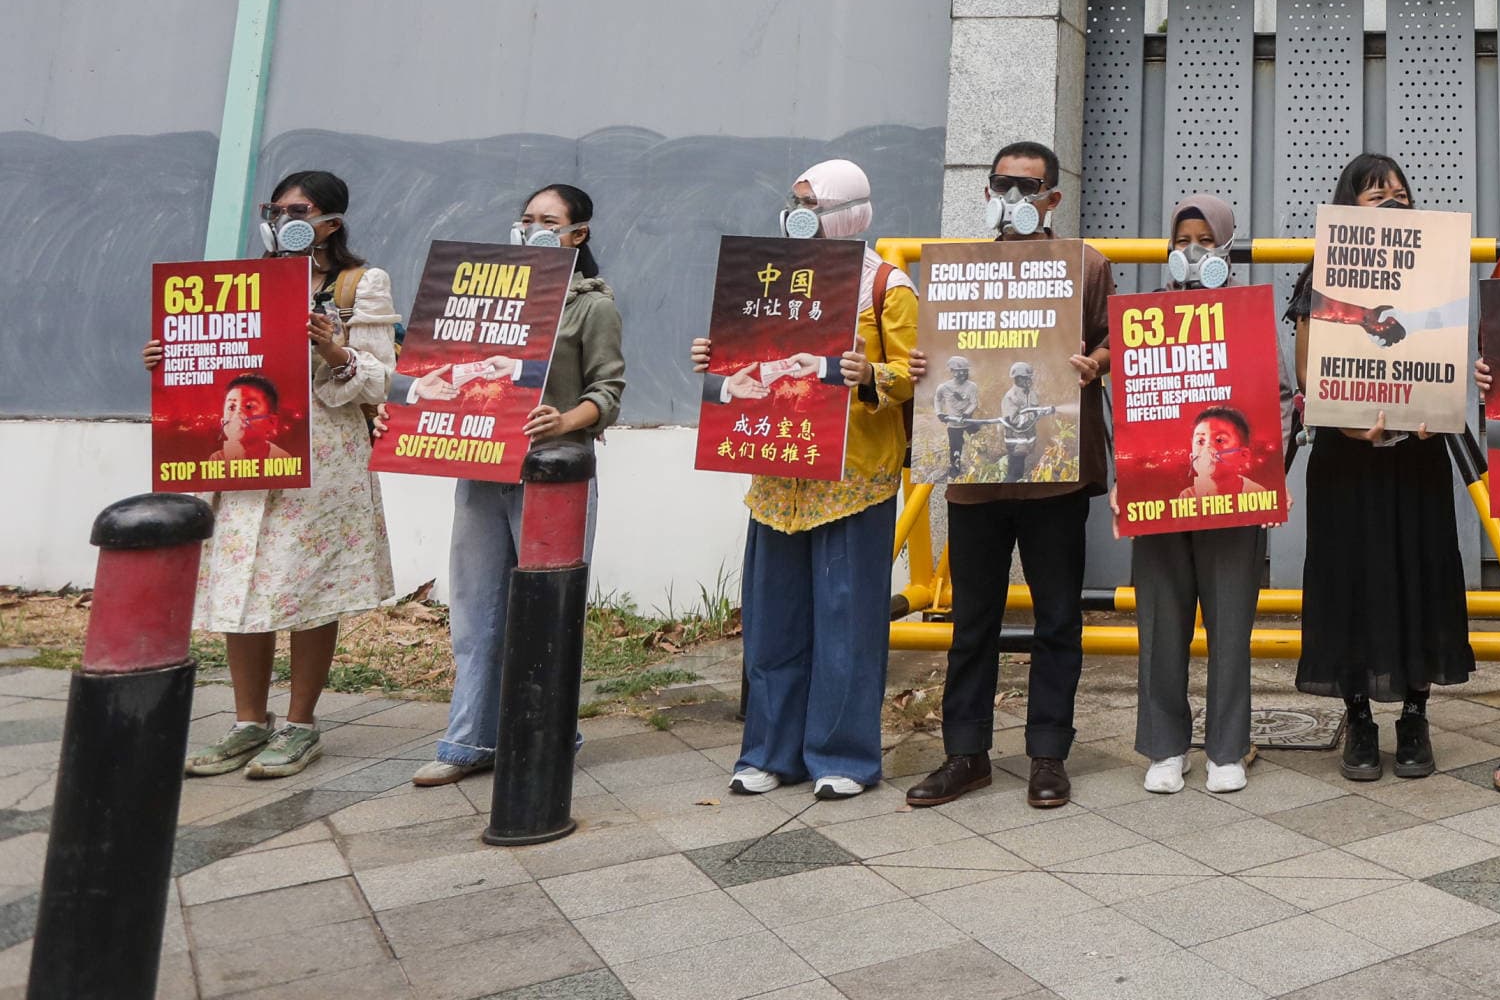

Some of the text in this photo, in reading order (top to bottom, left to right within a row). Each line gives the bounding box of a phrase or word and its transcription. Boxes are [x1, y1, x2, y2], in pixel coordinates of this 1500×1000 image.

[1328, 225, 1422, 249] TOXIC HAZE
[1327, 246, 1415, 269] KNOWS NO
[451, 262, 531, 299] CHINA
[757, 263, 815, 298] 中国
[931, 260, 1067, 281] ECOLOGICAL CRISIS
[1326, 268, 1402, 291] BORDERS
[164, 272, 260, 314] 63.711
[928, 280, 1073, 301] KNOWS NO BORDERS
[444, 296, 524, 321] DON'T LET
[743, 298, 823, 321] 别让贸易
[938, 309, 1056, 330] NEITHER SHOULD
[163, 312, 261, 342] CHILDREN
[433, 319, 530, 346] YOUR TRADE
[1122, 303, 1225, 348] 63.711
[164, 342, 248, 358] SUFFERING FROM
[958, 330, 1040, 350] SOLIDARITY
[164, 355, 264, 372] ACUTE RESPIRATORY
[1123, 342, 1227, 376] CHILDREN
[1320, 357, 1455, 383] NEITHER SHOULD
[164, 371, 213, 386] INFECTION
[1125, 373, 1214, 392] SUFFERING FROM
[1126, 386, 1232, 407] ACUTE RESPIRATORY
[1319, 380, 1413, 404] SOLIDARITY
[417, 411, 495, 439] FUEL OUR
[1126, 405, 1180, 422] INFECTION
[733, 414, 815, 441] 成为窒息
[395, 434, 505, 464] SUFFOCATION
[717, 437, 821, 465] 我们的推手
[160, 457, 301, 481] STOP THE FIRE NOW!
[1127, 491, 1278, 521] STOP THE FIRE NOW!
